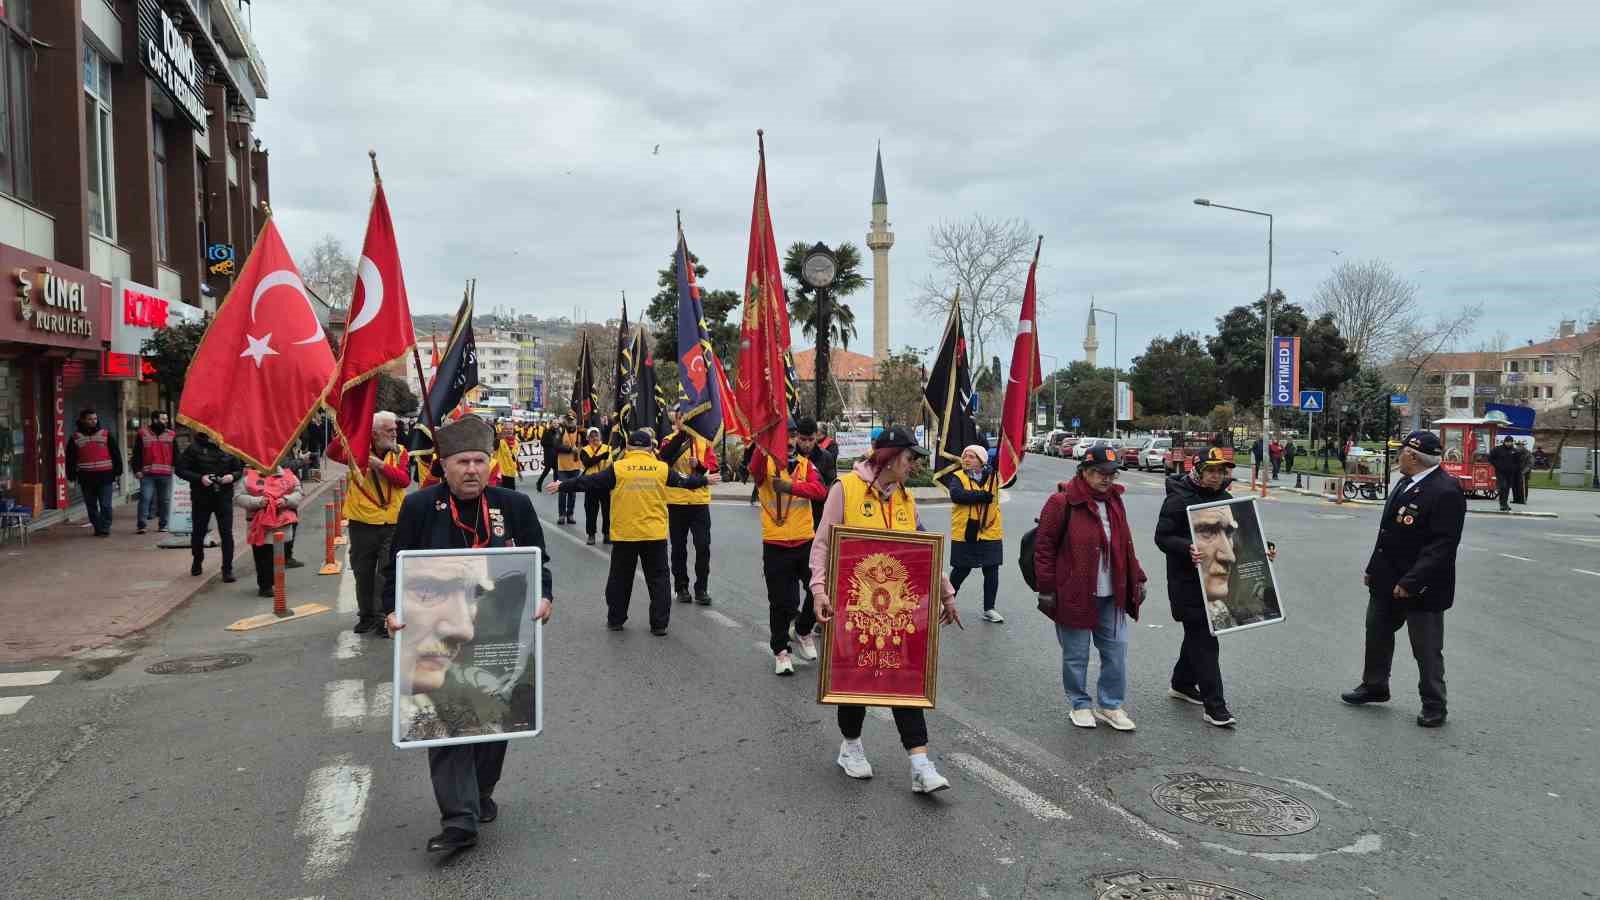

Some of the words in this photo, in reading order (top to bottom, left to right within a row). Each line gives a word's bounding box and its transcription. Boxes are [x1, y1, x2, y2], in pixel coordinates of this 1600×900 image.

[149, 39, 167, 83] CAFE
[44, 266, 88, 312] ÜNAL
[1279, 348, 1290, 402] OPTIMED
[56, 375, 66, 500] ECZANE
